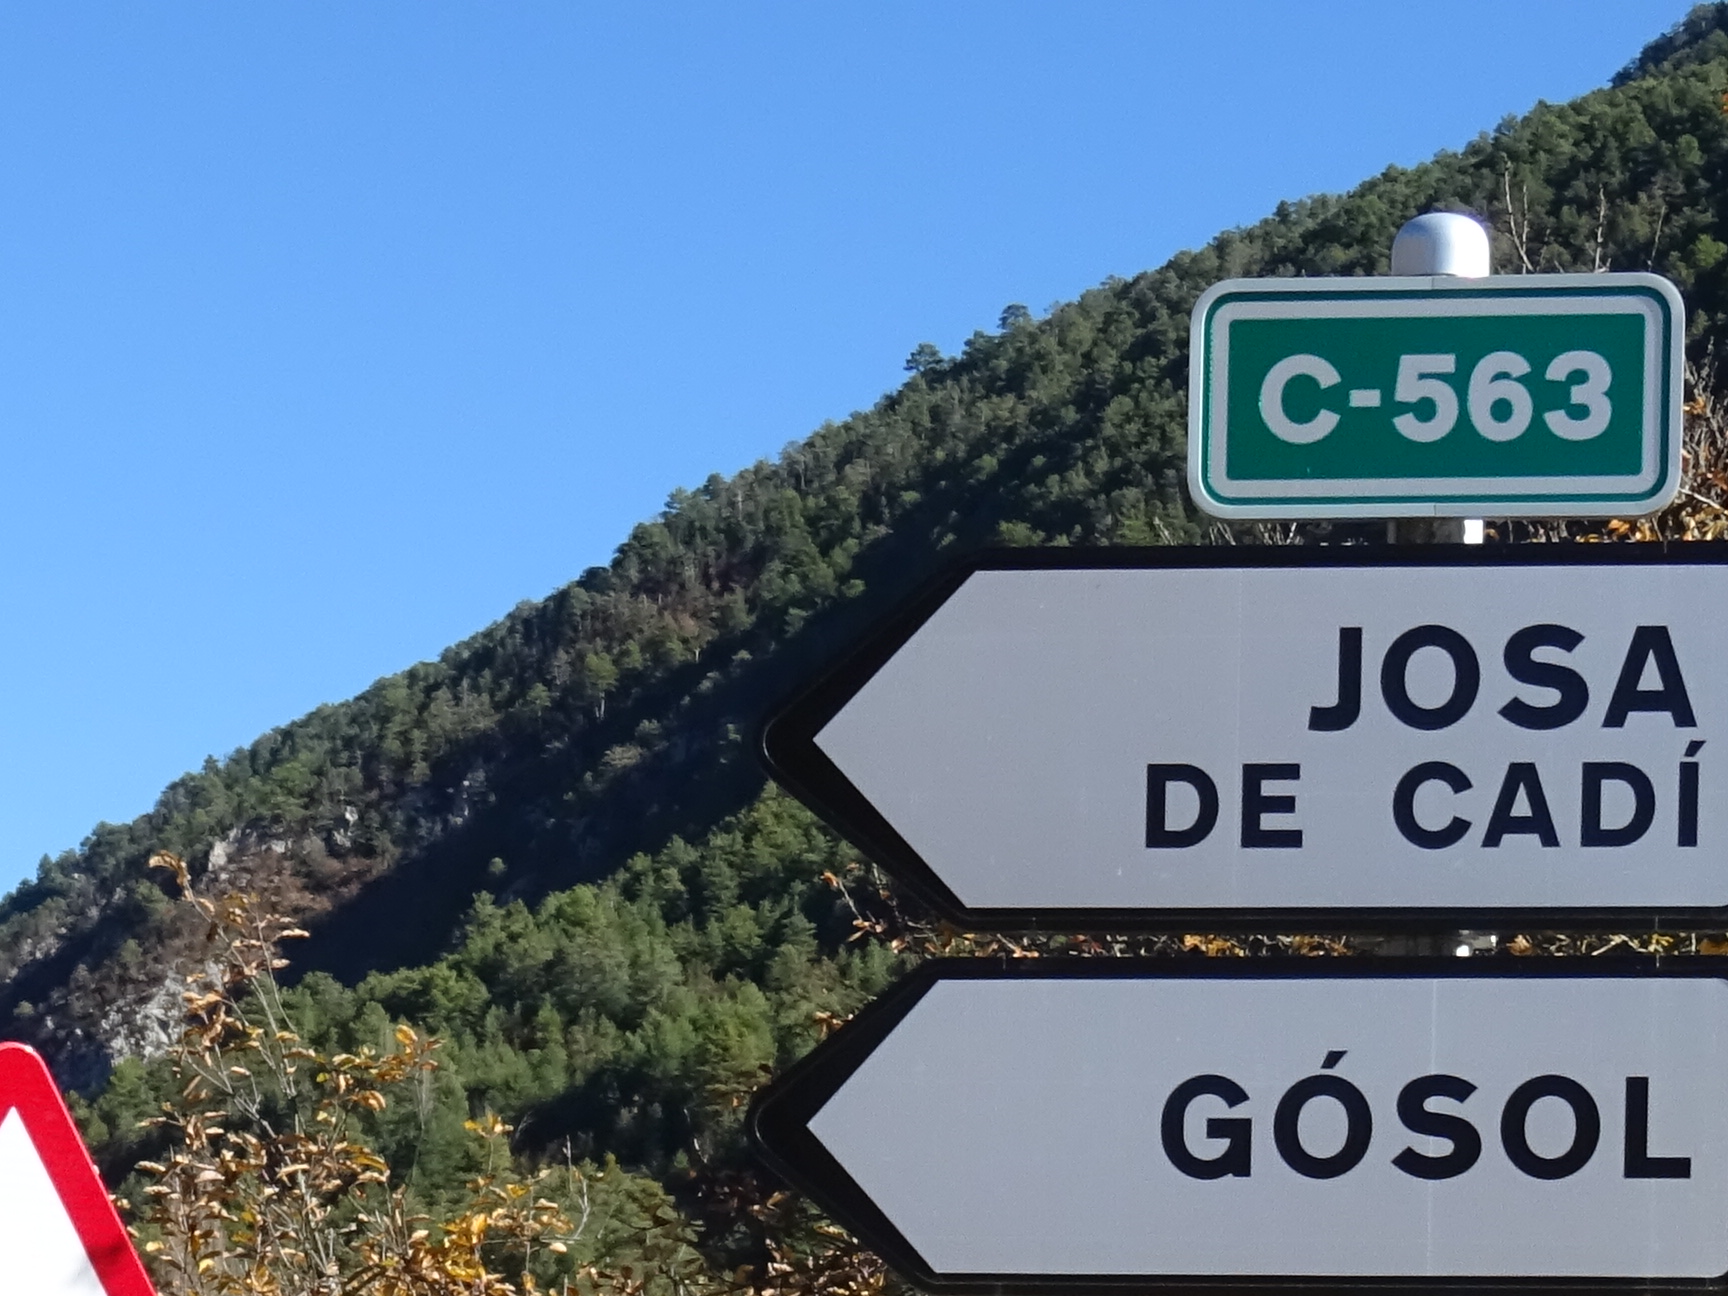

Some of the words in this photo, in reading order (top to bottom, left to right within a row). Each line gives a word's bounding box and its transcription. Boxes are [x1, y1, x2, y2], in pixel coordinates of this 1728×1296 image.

[1258, 350, 1612, 444] C-563
[1307, 623, 1698, 732] JOSA
[1145, 762, 1303, 849] DE
[1392, 739, 1707, 850] CADÍ
[1160, 1050, 1692, 1181] GÓSOL
